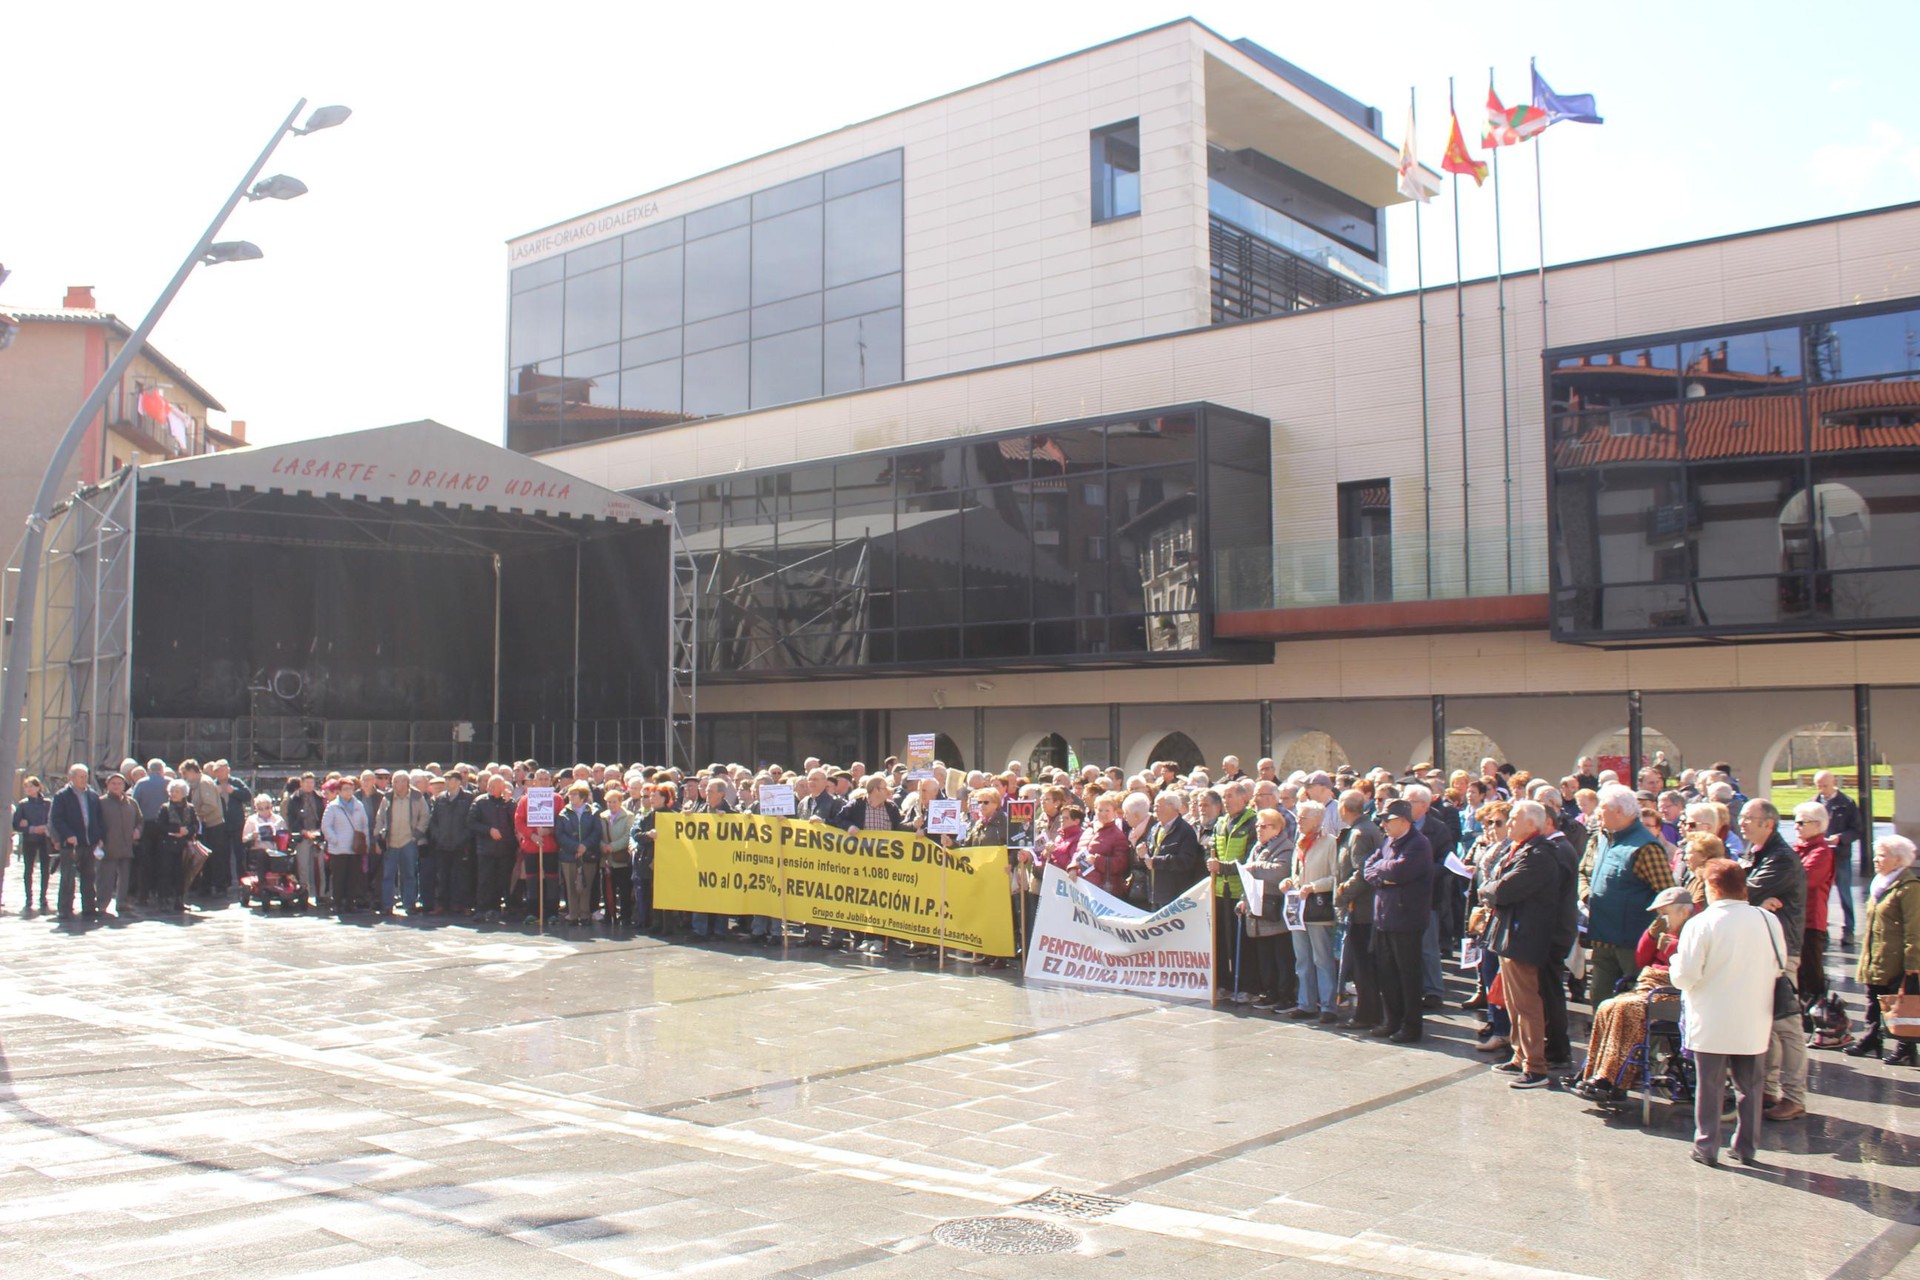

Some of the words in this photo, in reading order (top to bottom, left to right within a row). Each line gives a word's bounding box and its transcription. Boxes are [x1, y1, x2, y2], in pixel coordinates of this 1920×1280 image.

[511, 222, 595, 261] LASARTE-ORIAKO
[598, 201, 659, 234] UDALETXEA
[271, 457, 378, 482] LASARTE
[407, 469, 489, 492] ORIAKO
[504, 478, 571, 500] UDALA
[1011, 803, 1034, 817] NO
[675, 821, 710, 840] POR
[716, 822, 772, 844] UNAS
[781, 826, 905, 860] PENSIONES
[912, 842, 975, 875] DIGNAS
[732, 851, 774, 866] (Ninguna
[817, 860, 850, 875] inferior
[853, 868, 859, 876] a
[862, 867, 889, 880] 1.080
[892, 872, 918, 887] euros)
[698, 872, 717, 888] NO
[720, 873, 730, 889] al
[786, 878, 911, 913] REVALORIZACIÓN
[914, 896, 953, 919] I.P.C.
[1055, 879, 1069, 898] EL
[812, 906, 834, 919] Grupo
[836, 910, 845, 919] de
[846, 911, 880, 926] Jubilados
[882, 918, 888, 928] y
[888, 918, 931, 933] Pensionistas
[932, 925, 943, 935] de
[944, 928, 983, 944] Lasarte-Oria
[1072, 906, 1090, 926] NO
[1115, 927, 1136, 943] MI
[1135, 918, 1185, 941] VOTO
[1042, 956, 1064, 975] EZ
[1119, 970, 1156, 987] NIRE
[1157, 971, 1209, 990] BOTOA
